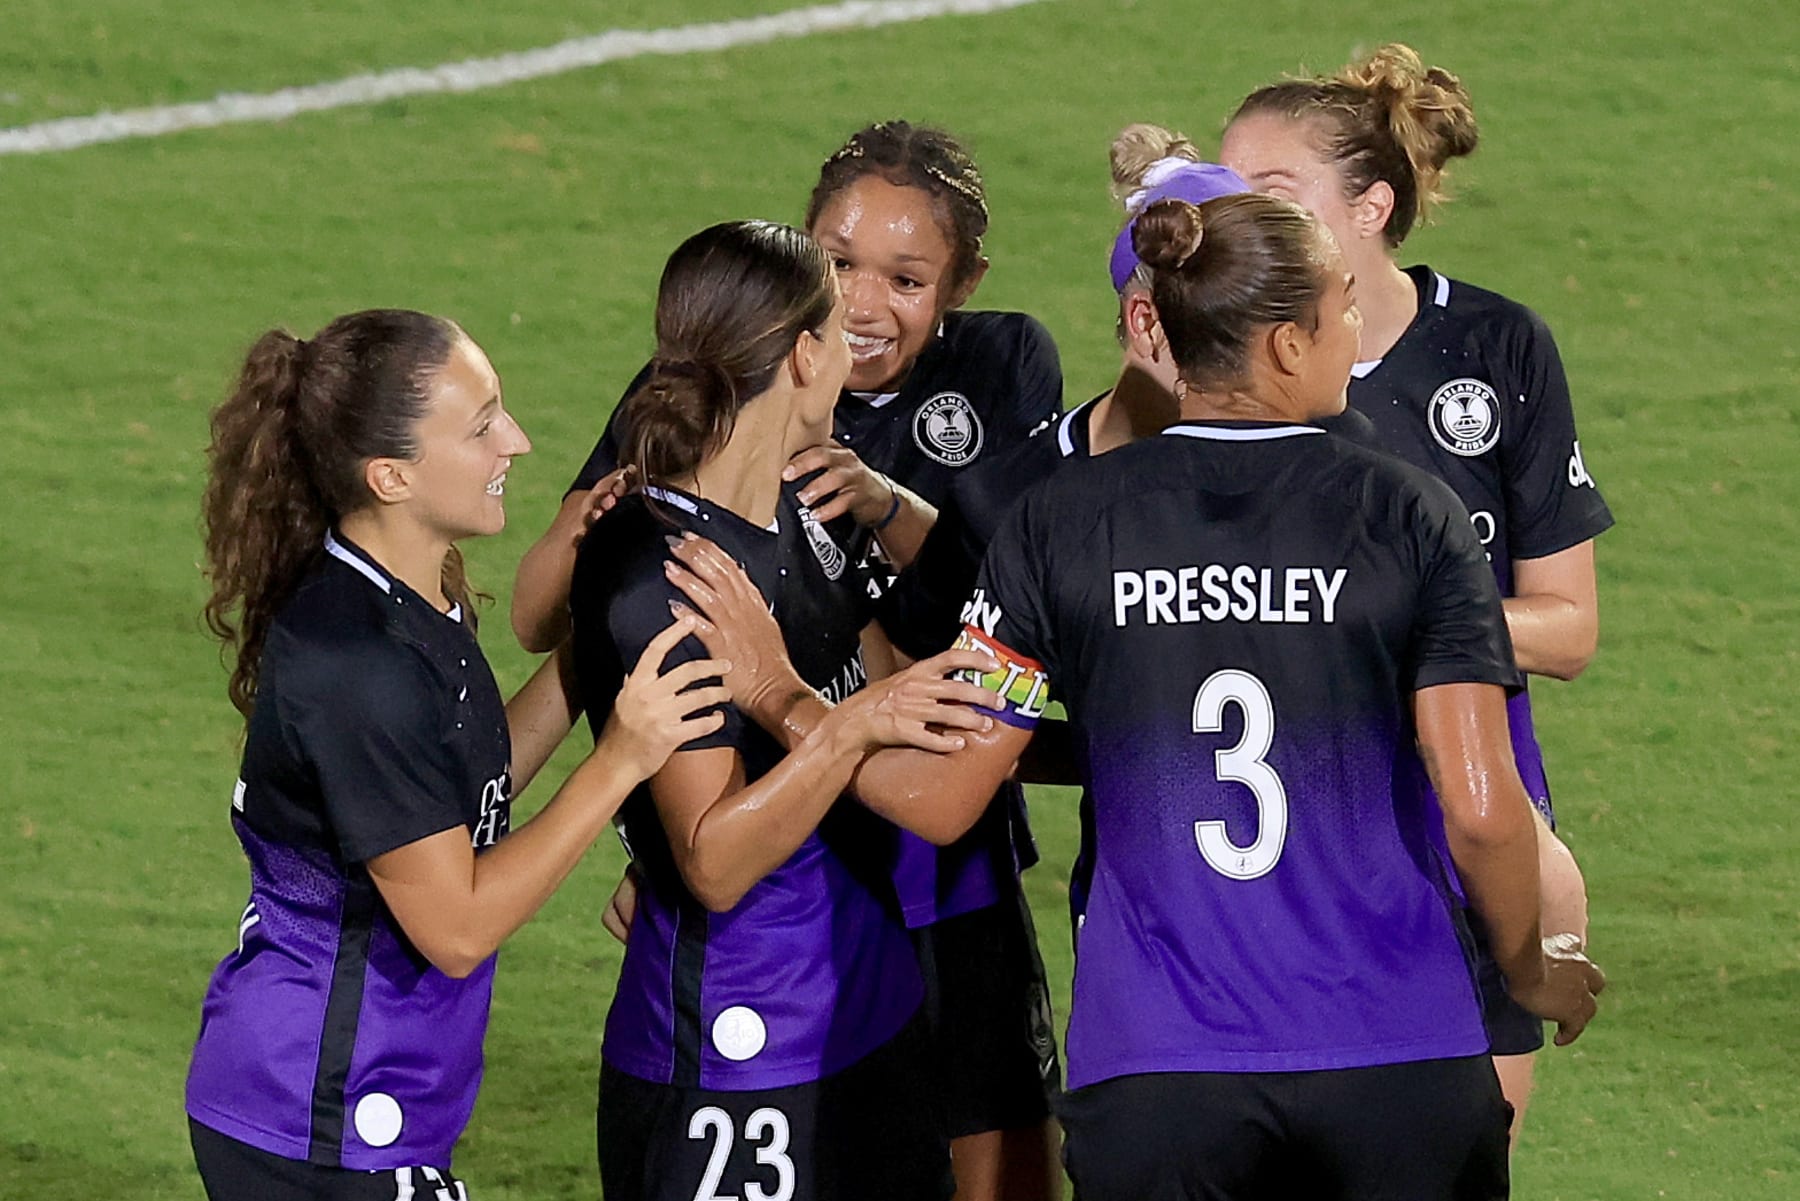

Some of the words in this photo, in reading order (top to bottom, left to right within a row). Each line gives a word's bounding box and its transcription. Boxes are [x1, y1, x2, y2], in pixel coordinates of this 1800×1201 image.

[921, 397, 969, 420] ORLANDO
[1437, 384, 1490, 405] ORLANDO
[1455, 439, 1485, 450] PRIDE
[1113, 564, 1348, 627] PRESSLEY
[1192, 669, 1288, 880] 3
[688, 1106, 796, 1201] 23
